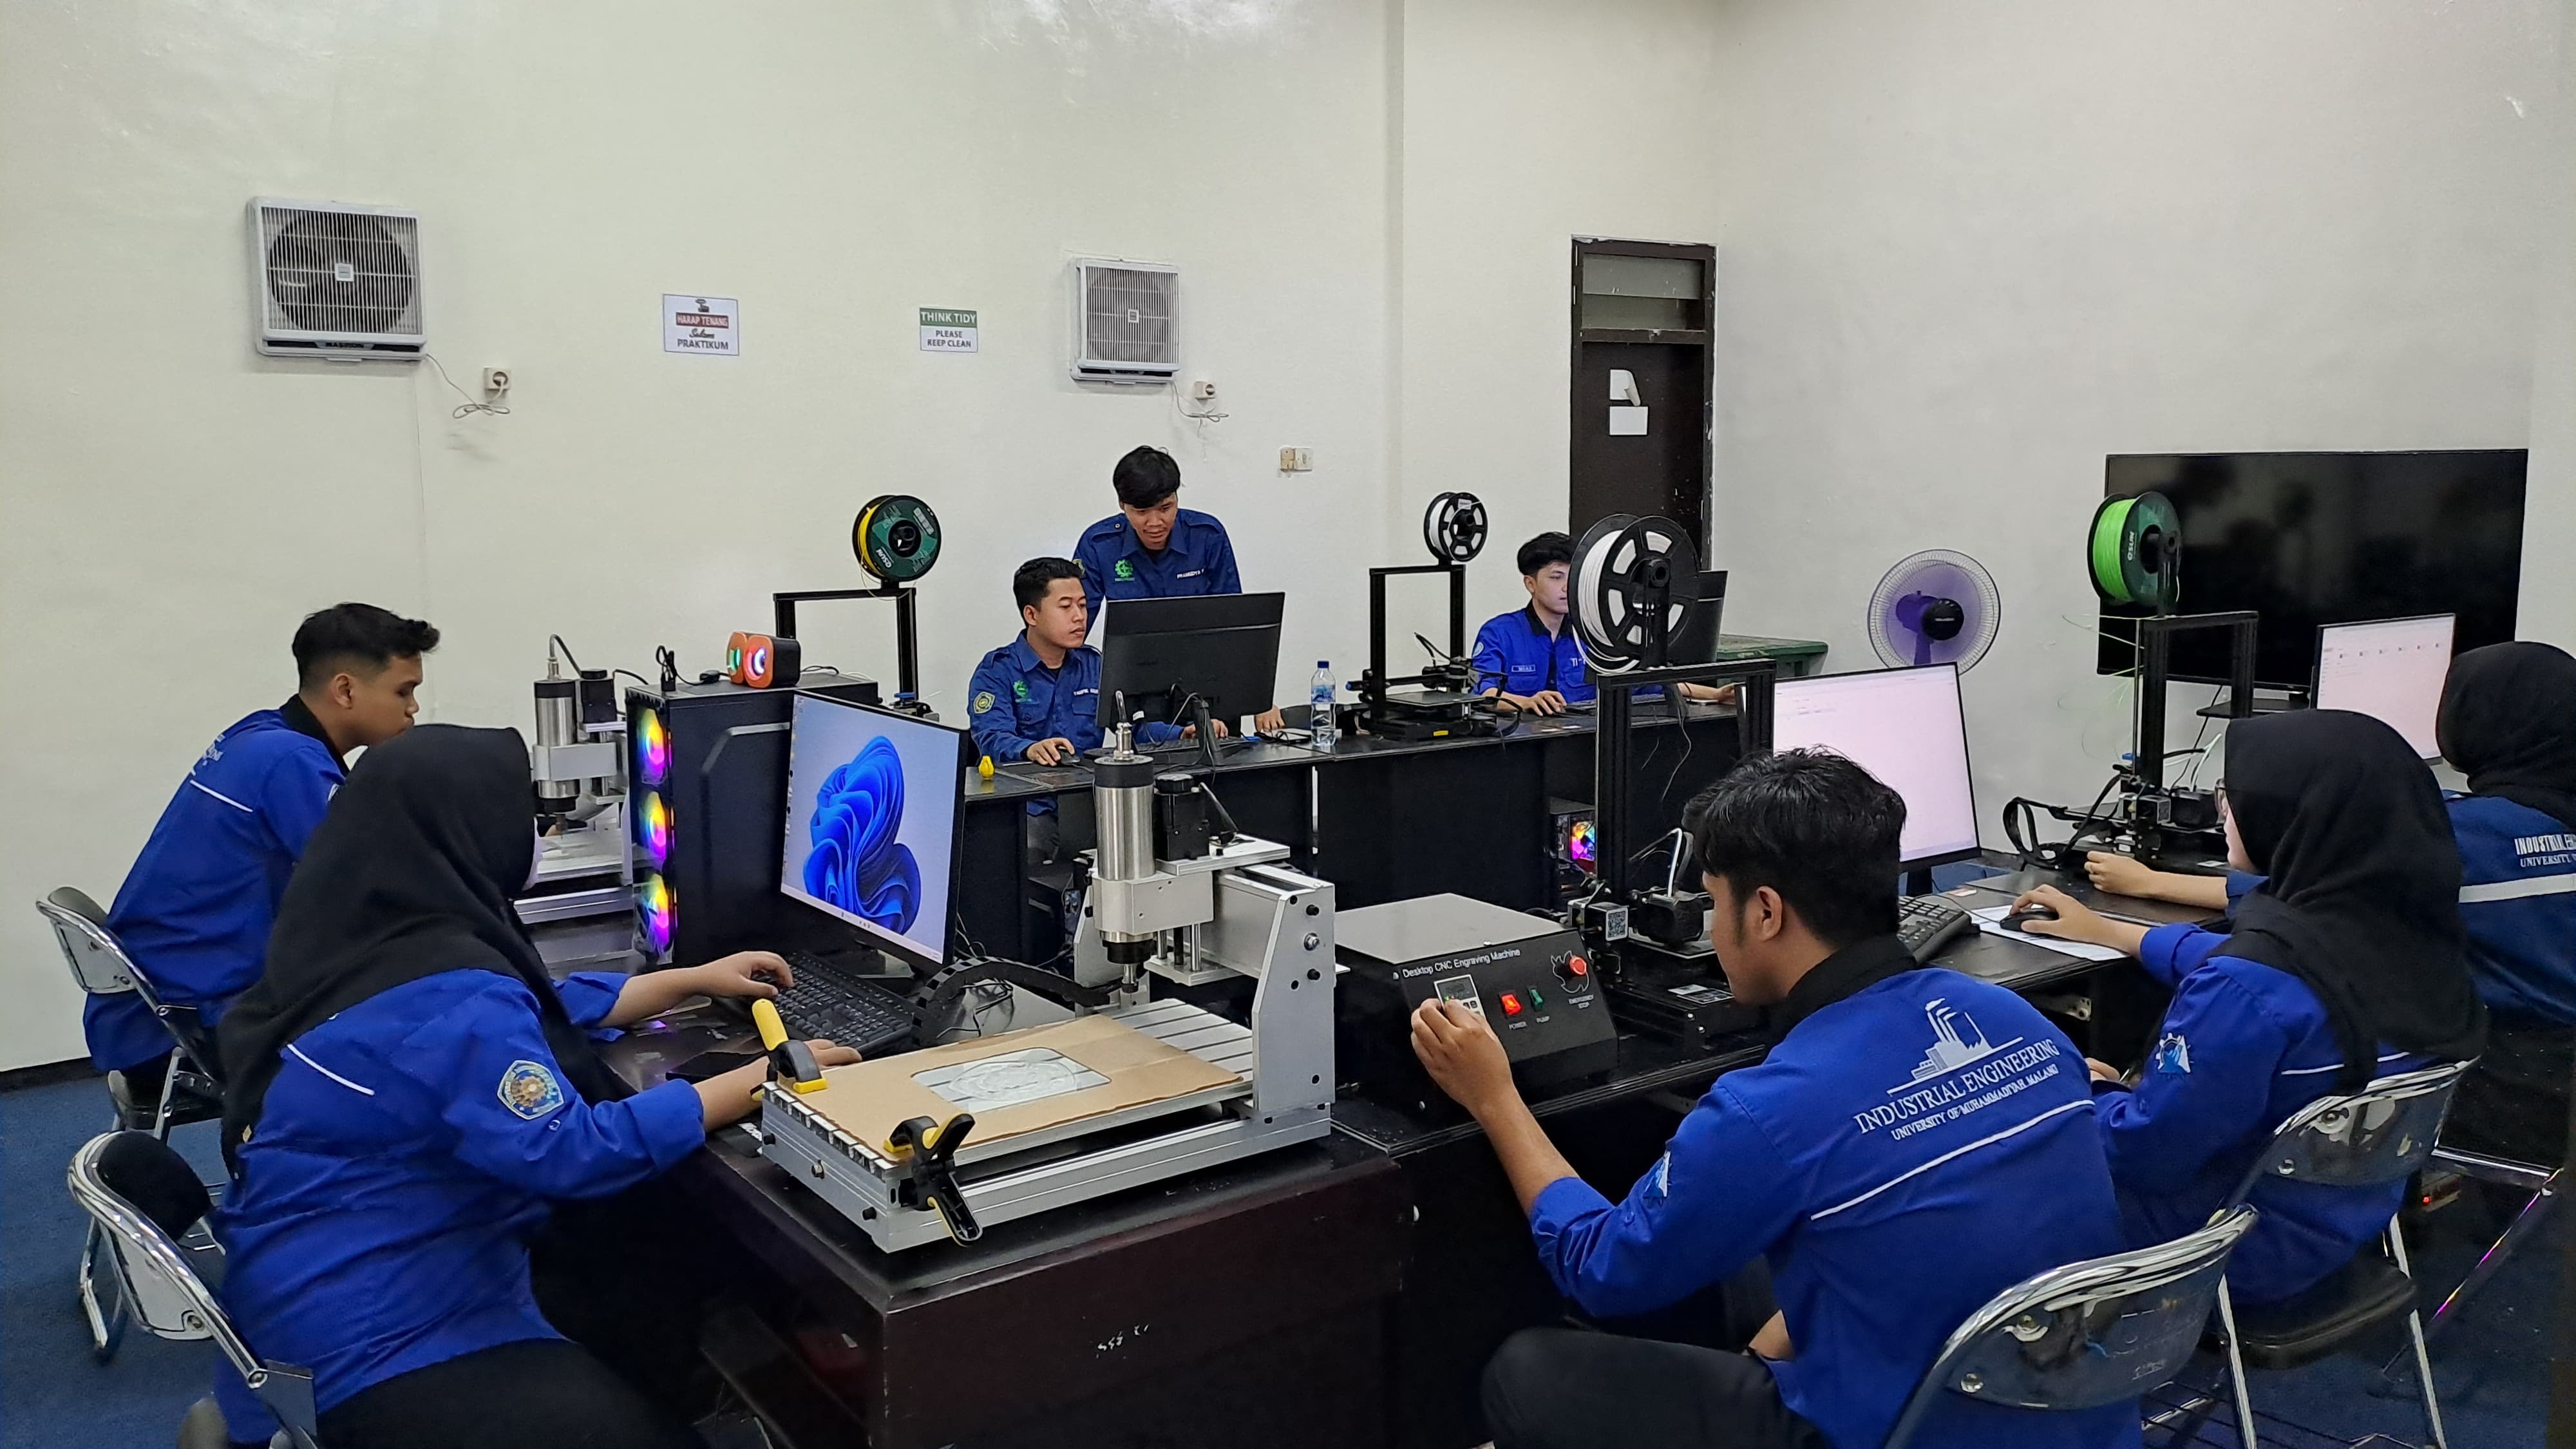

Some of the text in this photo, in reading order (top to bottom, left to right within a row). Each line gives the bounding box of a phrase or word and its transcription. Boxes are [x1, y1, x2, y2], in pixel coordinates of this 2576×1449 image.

[677, 314, 700, 325] HARAP
[921, 312, 976, 323] THINK TIDY
[936, 330, 963, 338] PLEASE
[677, 338, 729, 350] PRAKTIKUM
[947, 339, 971, 348] CLEAN
[1402, 949, 1521, 978] Desktop CNC Engraving Machine
[1853, 1039, 2060, 1134] INDUSTRIAL ENGINEERING
[1890, 1112, 1947, 1141] UNIVERSITY
[1947, 1106, 1960, 1120] OF
[1960, 1078, 2025, 1115] MUHAMMADIYAH
